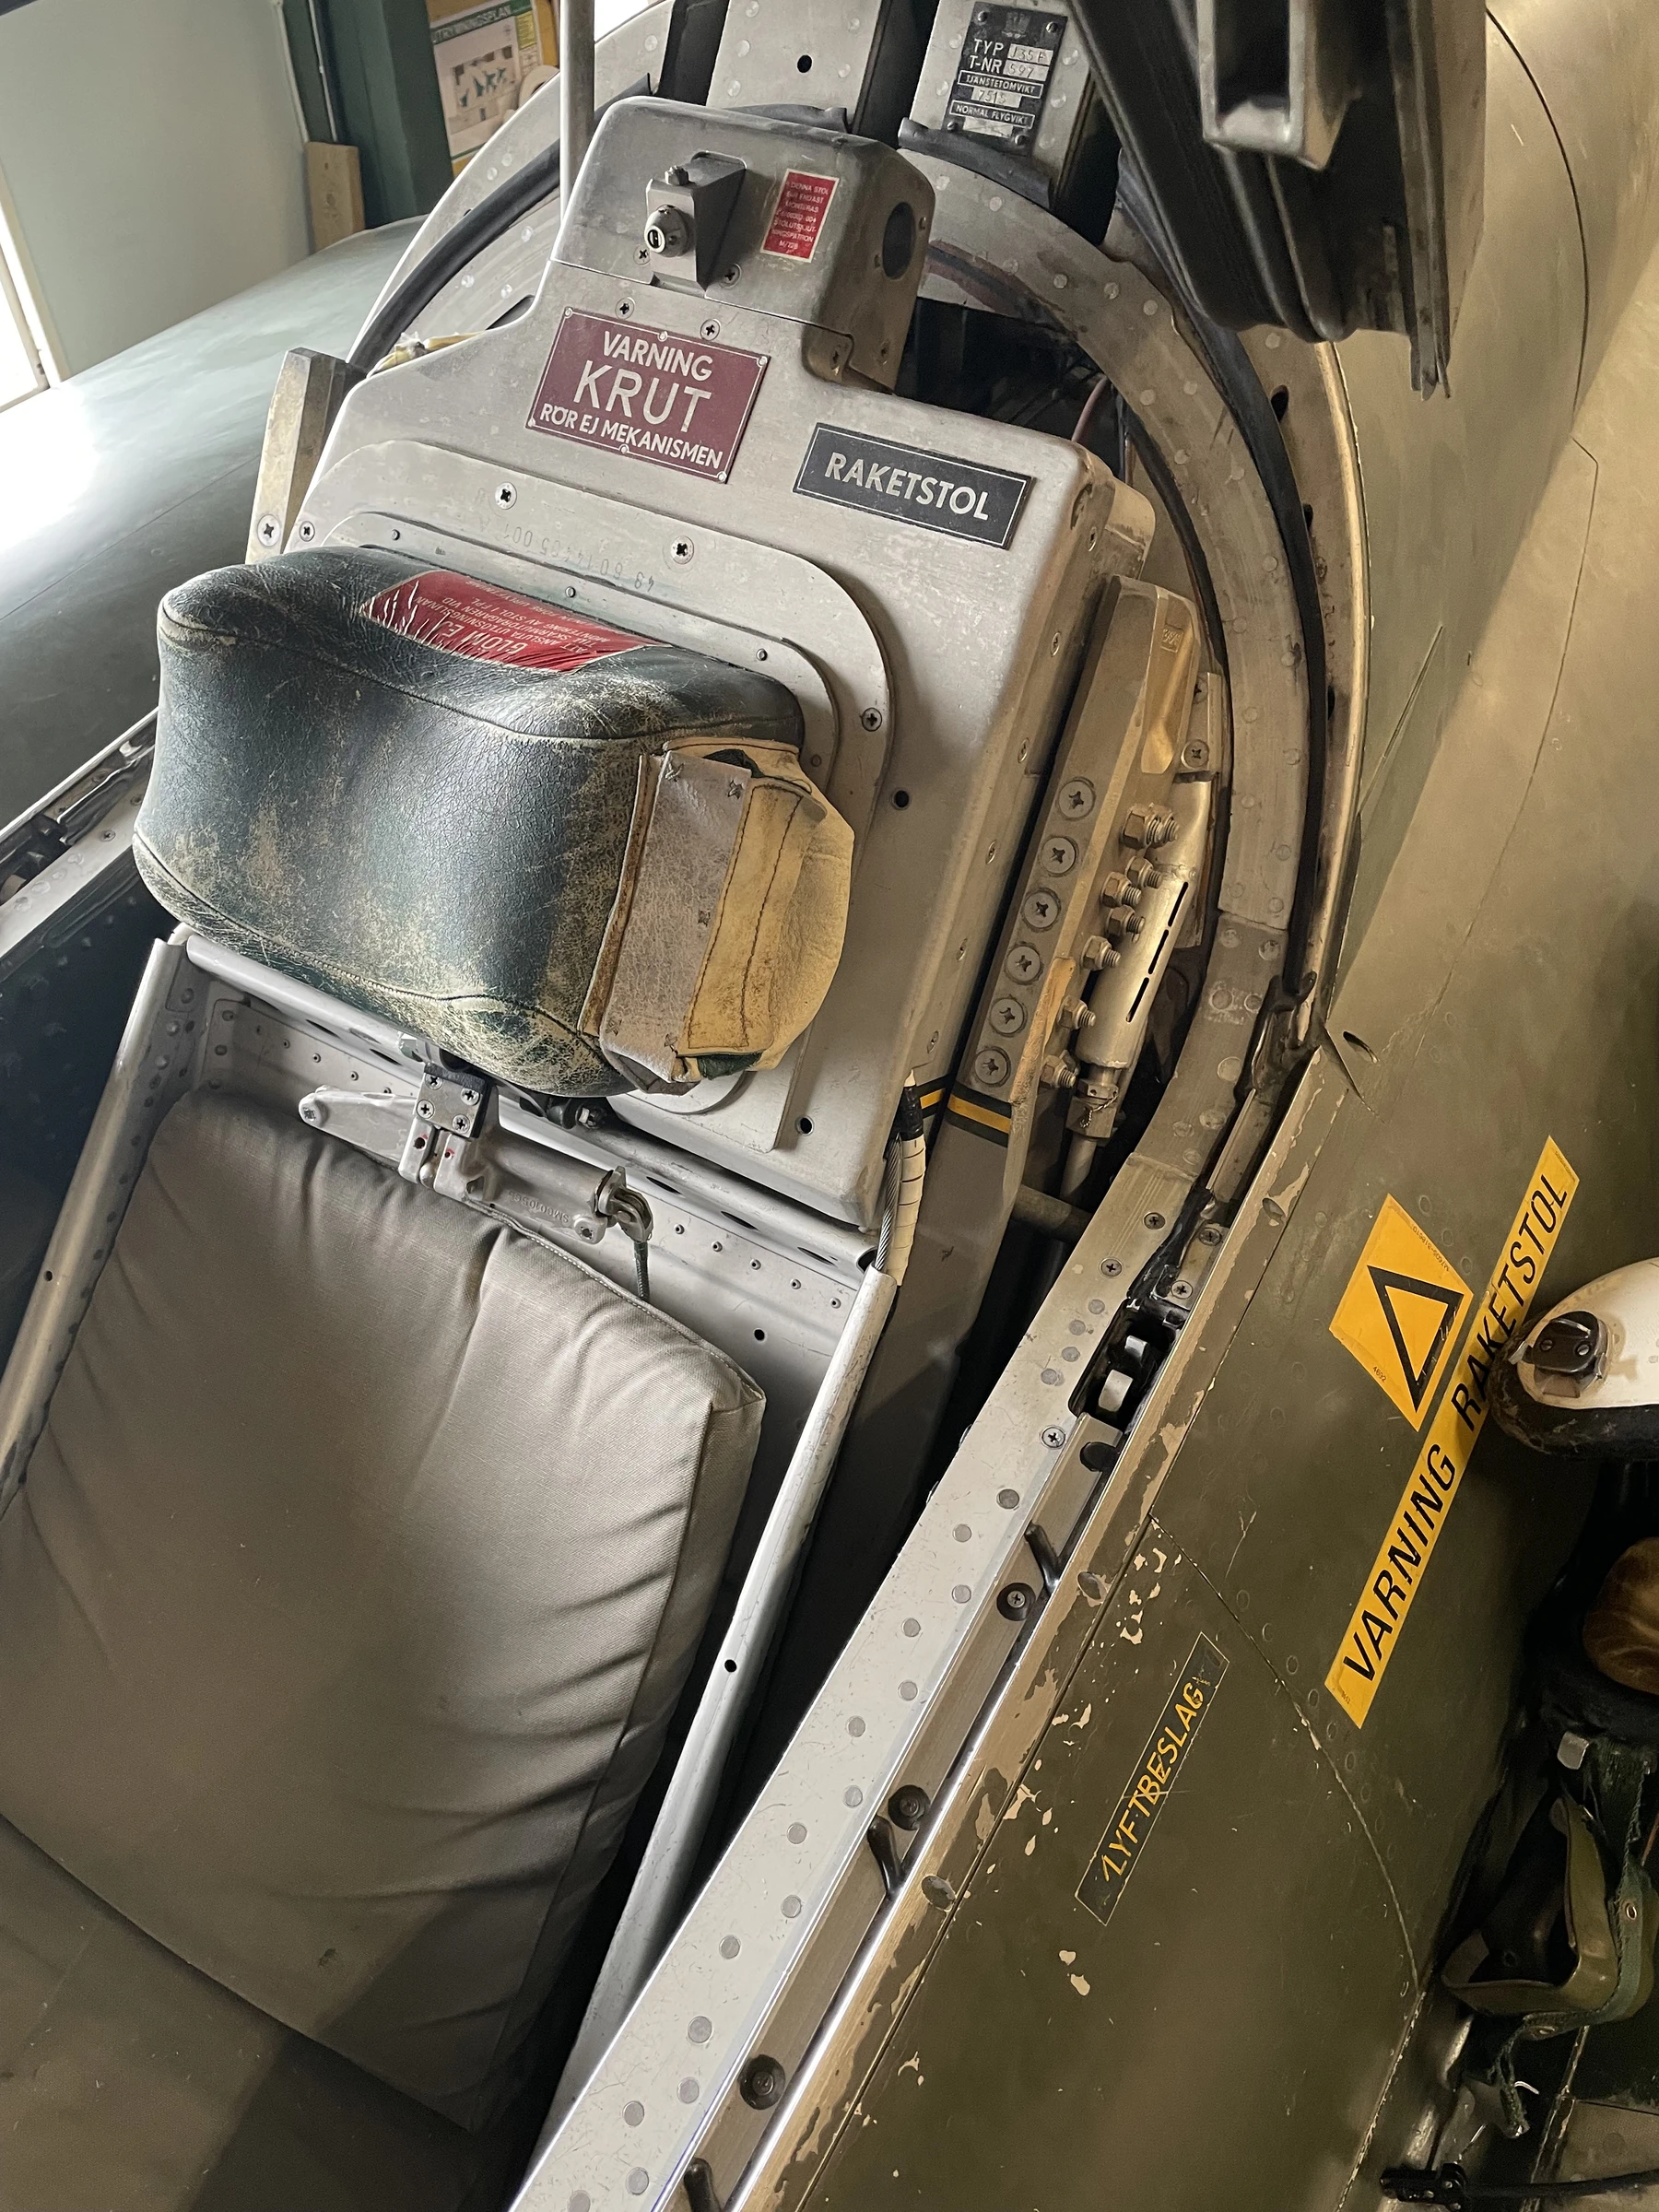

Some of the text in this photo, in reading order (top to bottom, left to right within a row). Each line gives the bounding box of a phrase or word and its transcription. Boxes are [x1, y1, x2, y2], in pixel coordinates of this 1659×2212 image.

[973, 38, 1004, 56] TYP
[969, 54, 1035, 79] T-NR 597
[956, 105, 1029, 125] NORMAL FLYGVIKT
[603, 331, 713, 382] VARNING
[573, 359, 712, 433] KRUT
[540, 403, 724, 469] RÖR EJ MEKANISMEN
[824, 453, 989, 521] RAKETSTOL
[442, 597, 462, 607] VID
[499, 608, 526, 621] STOL
[461, 630, 528, 653] GLÖM
[511, 630, 561, 646] ANSLUTA
[559, 643, 588, 654] ATT
[572, 638, 597, 648] TILL
[1342, 1173, 1567, 1681] VARNING RAKETSTOL
[1101, 1682, 1205, 1878] LYFTBESLAG
